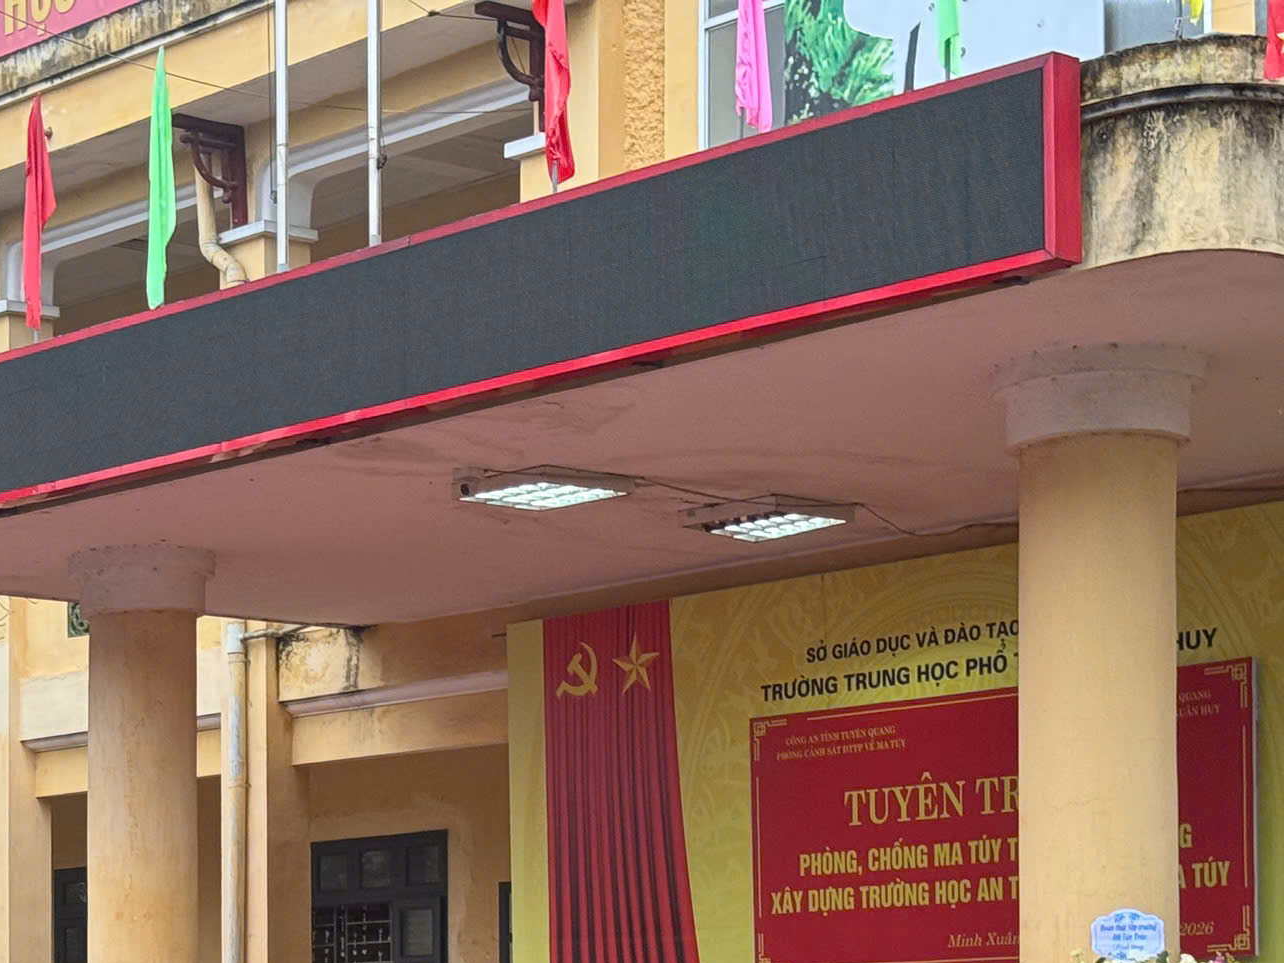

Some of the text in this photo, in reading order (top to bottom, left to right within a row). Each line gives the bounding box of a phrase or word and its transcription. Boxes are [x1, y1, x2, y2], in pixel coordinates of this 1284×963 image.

[806, 640, 827, 663] SỞ
[832, 637, 871, 660] GIÁO
[876, 634, 911, 657] DỤC
[916, 627, 939, 647] VÀ
[944, 622, 981, 645] ĐÀO
[761, 675, 838, 702] TRƯỜNG
[844, 667, 910, 692] TRUNG
[917, 660, 959, 687] HỌC
[965, 642, 1008, 677] PHỔ
[868, 725, 896, 738] QUANG
[844, 771, 966, 826] TUYÊN
[799, 847, 863, 876] PHÒNG,
[868, 837, 928, 871] CHỐNG
[933, 843, 964, 867] MA
[968, 834, 1002, 864] TÚY
[771, 886, 803, 915] XÂY
[808, 887, 854, 916] DỰNG
[860, 878, 930, 909] TRƯỜNG
[935, 879, 971, 909] HỌC
[977, 876, 1004, 901] AN
[1192, 856, 1231, 888] TÚY
[948, 932, 982, 948] Minh
[1179, 920, 1214, 936] 2026
